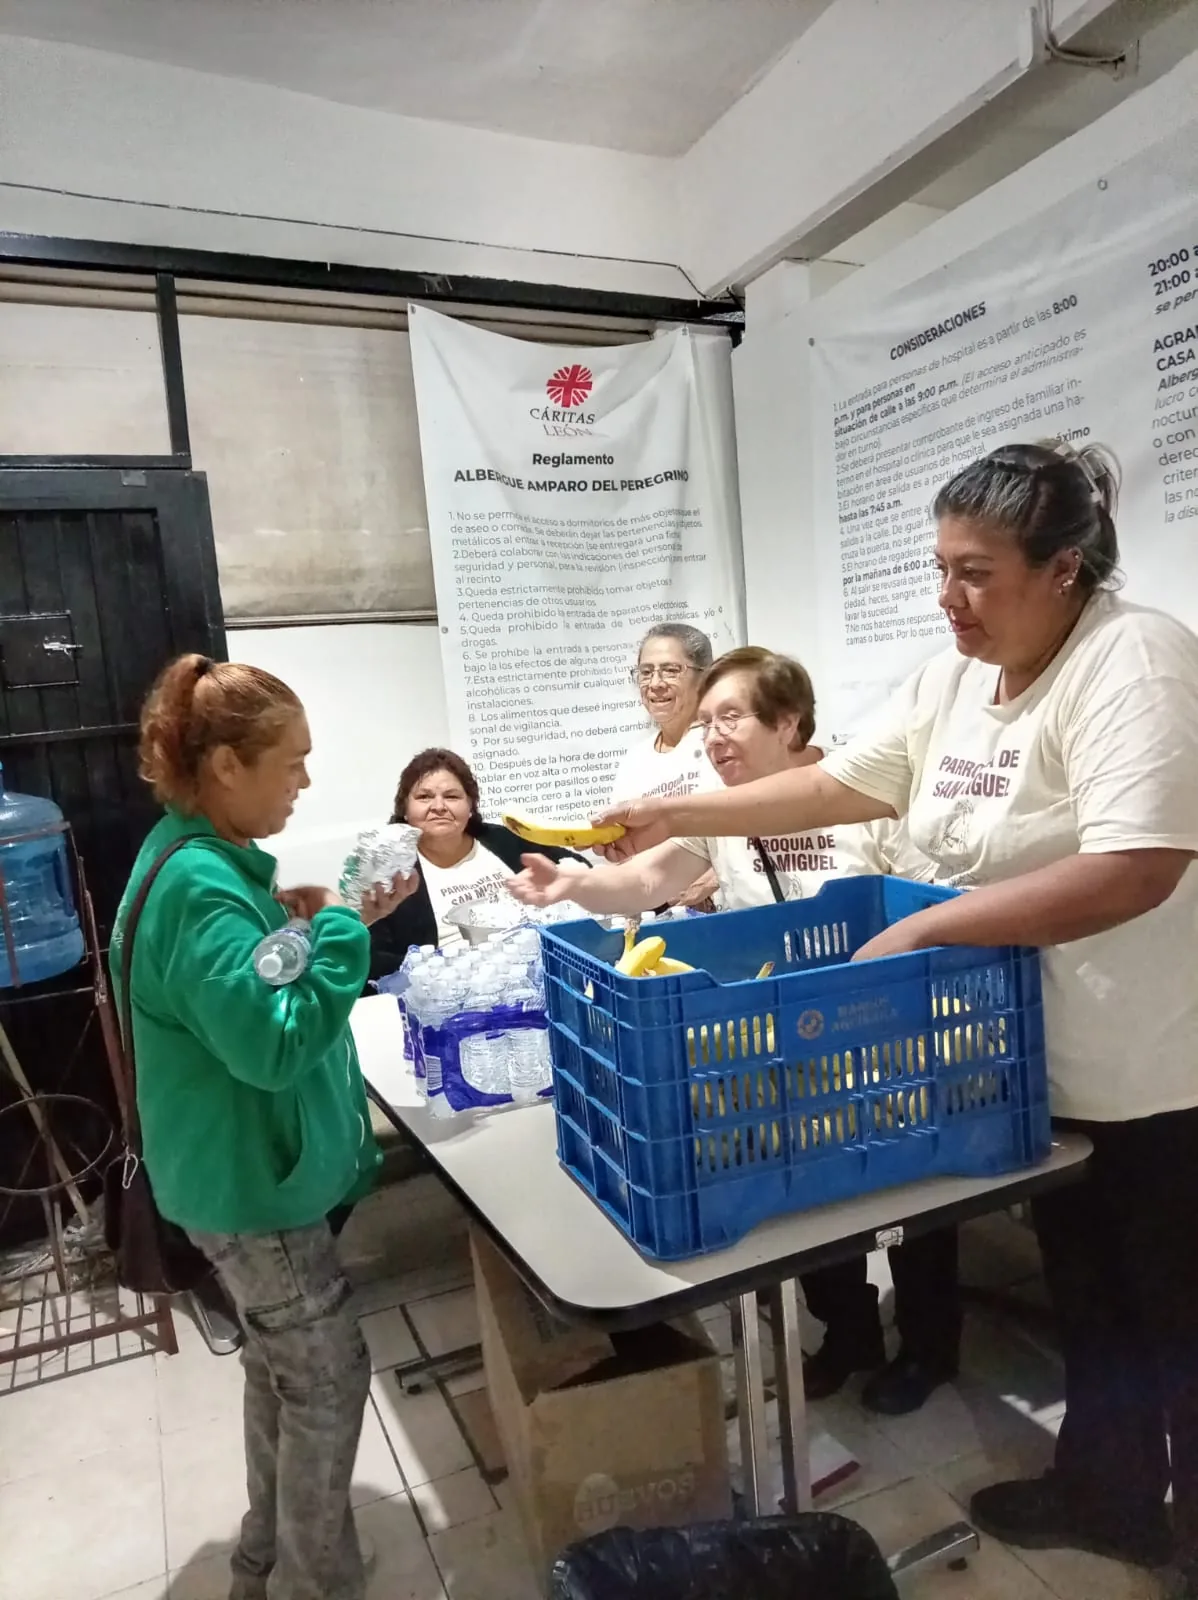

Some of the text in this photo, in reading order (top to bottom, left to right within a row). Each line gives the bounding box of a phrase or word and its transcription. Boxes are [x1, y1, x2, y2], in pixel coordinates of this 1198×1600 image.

[1147, 248, 1190, 277] 20:00
[1153, 270, 1191, 297] 21:00
[1155, 300, 1172, 315] se
[890, 301, 986, 360] CONSIDERACIONES
[929, 360, 940, 371] de
[941, 342, 976, 367] hospital
[977, 338, 988, 350] es
[988, 335, 996, 344] a
[995, 321, 1020, 344] partir
[1022, 316, 1036, 329] de
[1036, 308, 1053, 321] las
[1052, 294, 1078, 315] 8:00
[1156, 347, 1196, 371] CASA
[869, 413, 878, 424] de
[904, 396, 916, 408] las
[917, 386, 936, 402] 9:00
[1073, 328, 1087, 341] es
[872, 382, 916, 410] personas en
[941, 393, 958, 407] que
[1154, 390, 1185, 411] lucro
[964, 384, 1065, 428] de ingreso de familiar
[530, 406, 595, 424] CÁRITAS
[937, 401, 1065, 454] para que le sea asignada una
[1152, 428, 1196, 449] o con
[532, 453, 614, 467] Reglamento
[892, 455, 951, 481] de usuarios de
[454, 469, 688, 492] ALBERGUE AMPARO DEL PEREGRINO
[876, 477, 930, 500] de salida es a
[1164, 490, 1183, 505] las
[457, 511, 628, 526] No se de
[858, 508, 869, 518] las
[875, 506, 922, 528] que se entre
[1164, 510, 1176, 524] la
[450, 524, 499, 533] de aseo o
[503, 535, 512, 544] al
[903, 536, 912, 546] se
[454, 561, 504, 573] seguridad
[842, 560, 921, 587] por la mañana de 6:00
[455, 574, 501, 584] al recinto
[871, 583, 880, 592] se
[907, 574, 923, 586] que
[923, 571, 931, 581] la
[458, 597, 539, 611] pertenencias de
[471, 608, 556, 623] Queda prohibido
[860, 608, 867, 619] la
[508, 621, 558, 634] prohibido
[867, 624, 947, 643] o Por lo que no
[475, 647, 542, 659] Se la
[464, 657, 567, 674] bajo la los efectos de
[498, 670, 567, 683] estrictamente
[533, 680, 580, 693] consumir
[480, 706, 569, 722] Los alimentos que
[469, 723, 511, 735] sonal de
[483, 736, 500, 745] Por
[503, 734, 514, 744] su
[570, 729, 584, 738] no
[489, 748, 628, 770] Después de la hora de dormir
[998, 749, 1021, 768] DE
[509, 761, 612, 781] en voz alta o molestar
[488, 775, 598, 795] No correr por pasillos o
[541, 788, 582, 802] cero a la
[555, 801, 591, 813] respeto
[817, 834, 836, 850] DE
[451, 892, 473, 905] SAN
